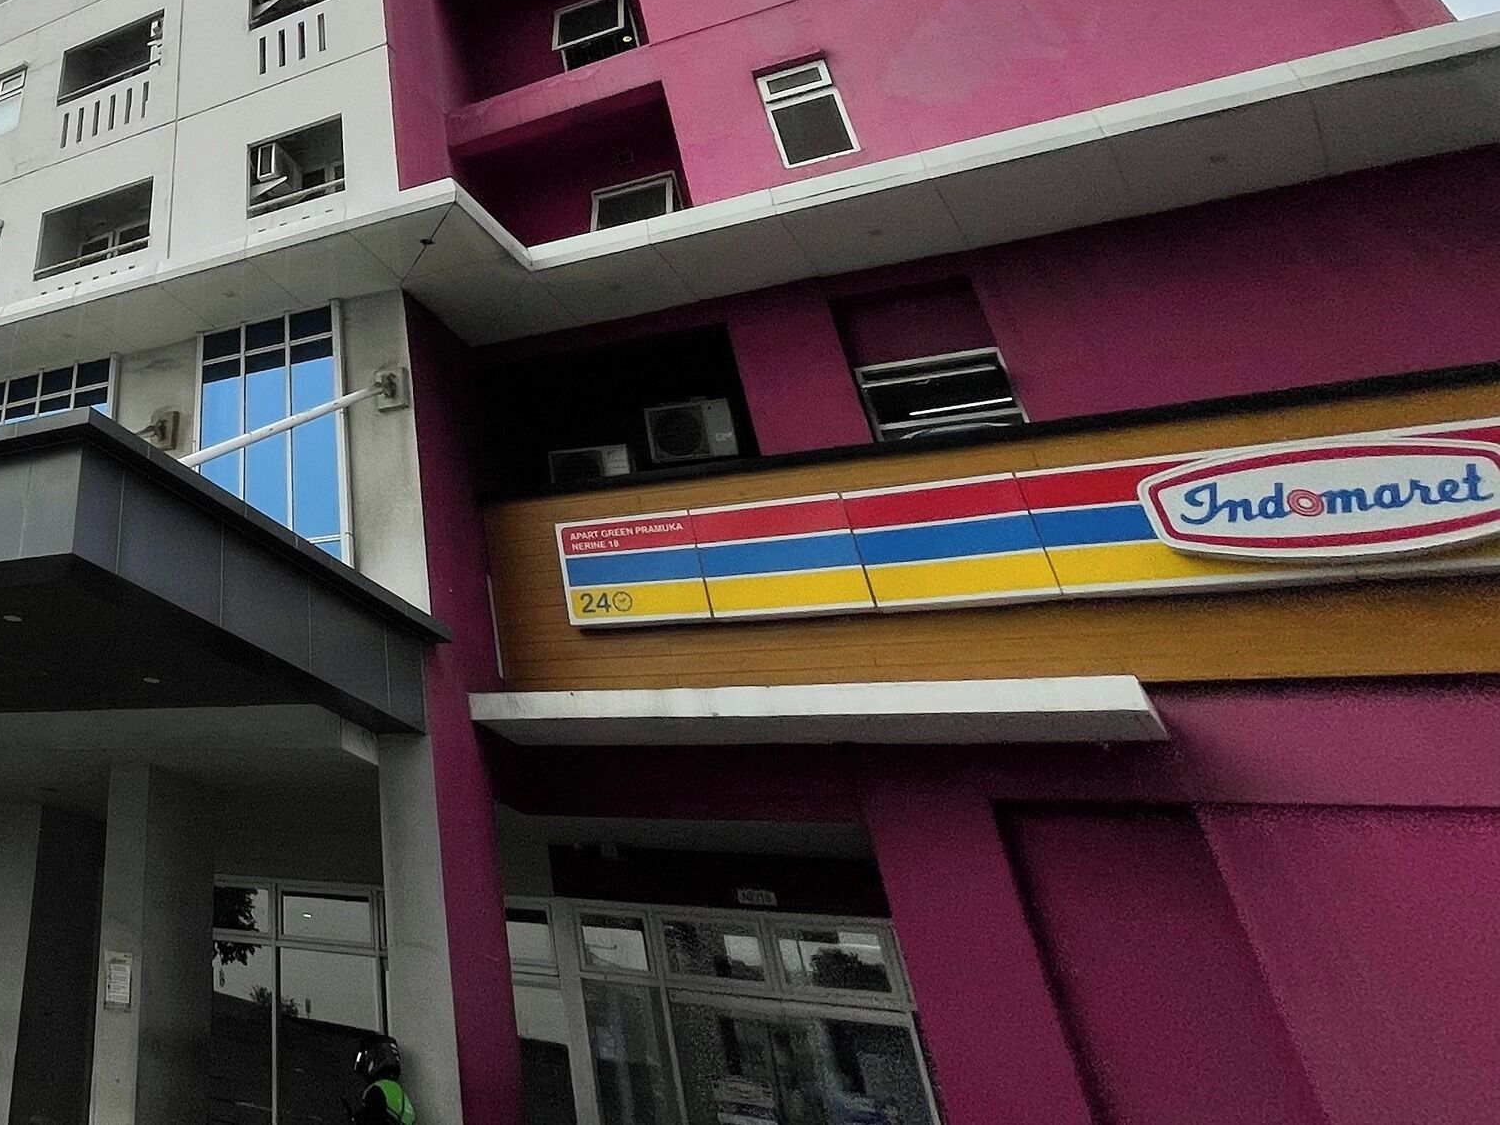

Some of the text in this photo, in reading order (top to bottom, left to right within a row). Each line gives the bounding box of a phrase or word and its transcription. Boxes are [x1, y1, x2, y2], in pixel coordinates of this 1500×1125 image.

[1181, 463, 1494, 525] Indomaret
[570, 523, 684, 541] APART GREEN PRAMUKA
[571, 540, 607, 551] NERINE
[580, 592, 612, 614] 24
